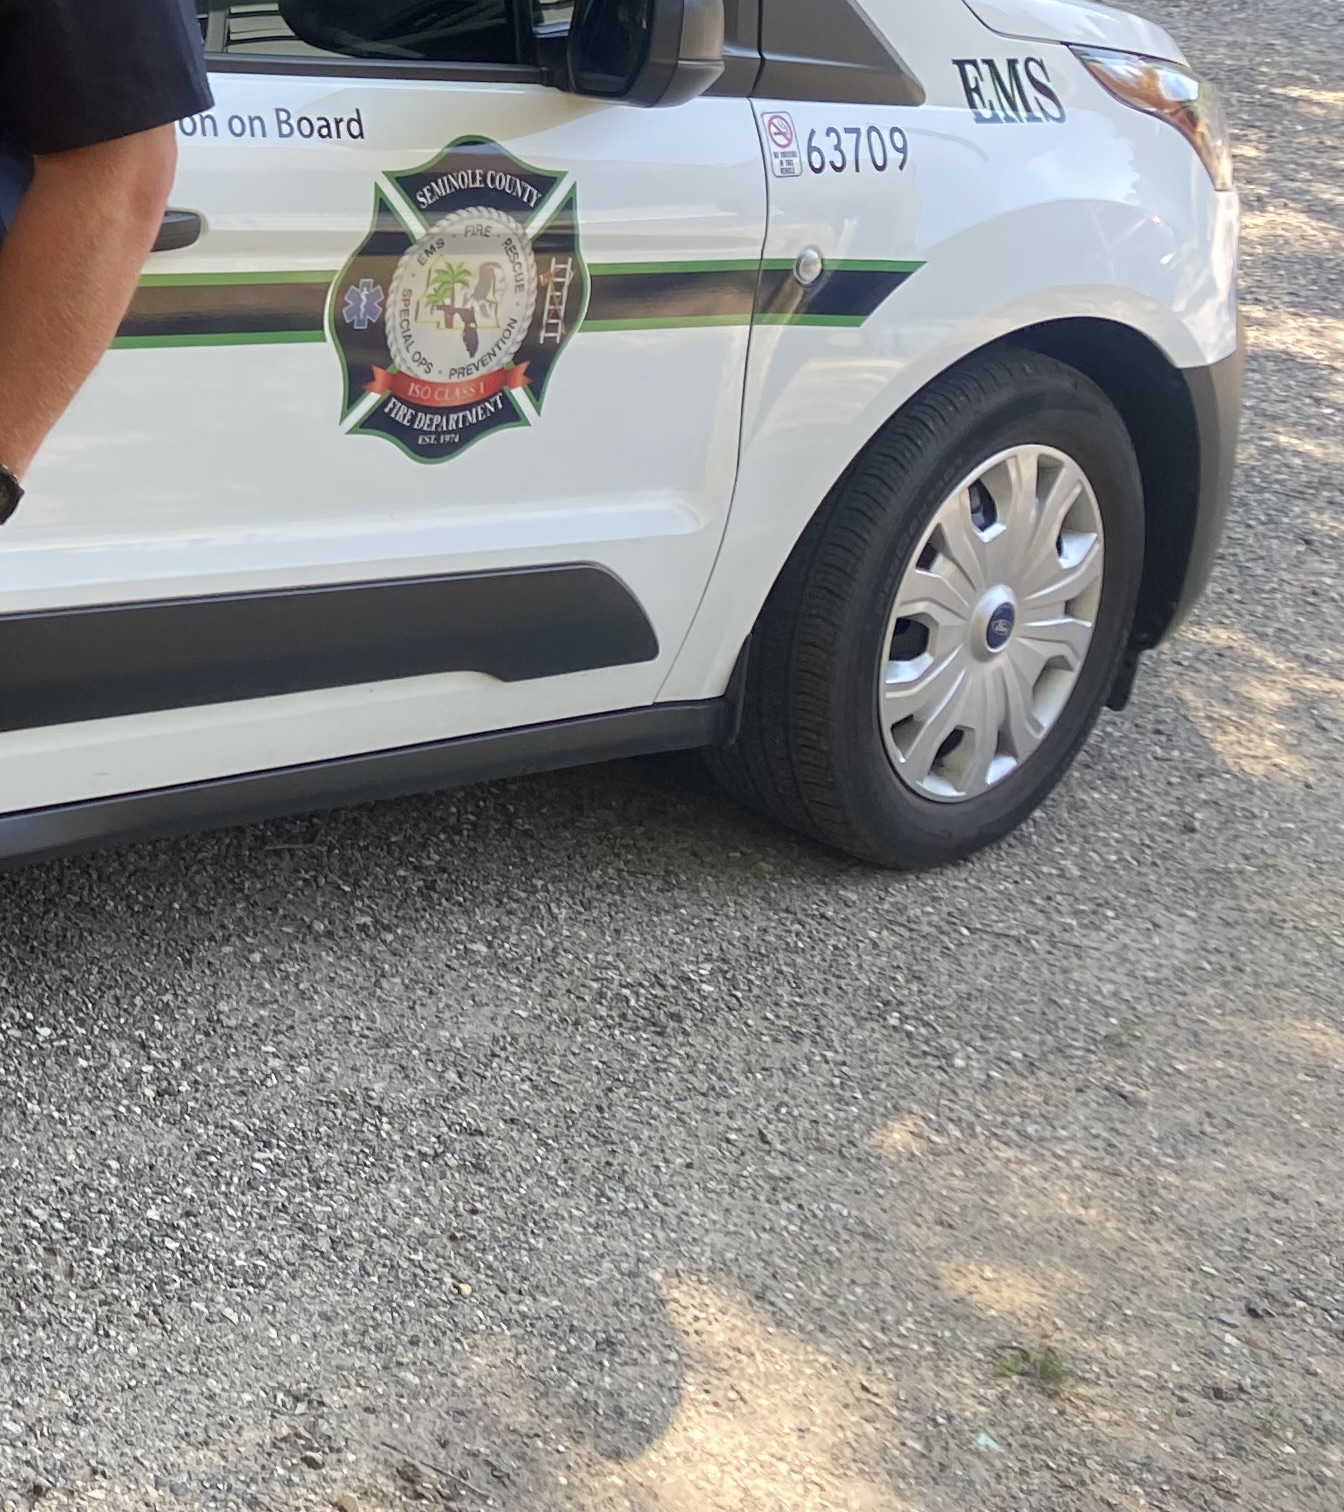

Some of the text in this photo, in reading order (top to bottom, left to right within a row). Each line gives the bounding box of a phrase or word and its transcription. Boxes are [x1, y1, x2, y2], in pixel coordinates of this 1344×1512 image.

[951, 56, 1067, 124] EMS
[227, 114, 267, 138] on
[274, 107, 366, 140] Board
[806, 125, 909, 175] 63709
[416, 168, 542, 210] SEMINOLE COUNTY
[417, 237, 446, 267] EMS
[463, 223, 493, 239] FIRE
[501, 236, 526, 295] RESCUE
[398, 288, 435, 376] SPECIAL OPS
[448, 316, 518, 381] PREVENTION
[383, 392, 505, 432] FIRE DEPARTMENT
[407, 381, 432, 400] ISO
[433, 385, 477, 402] CLASS
